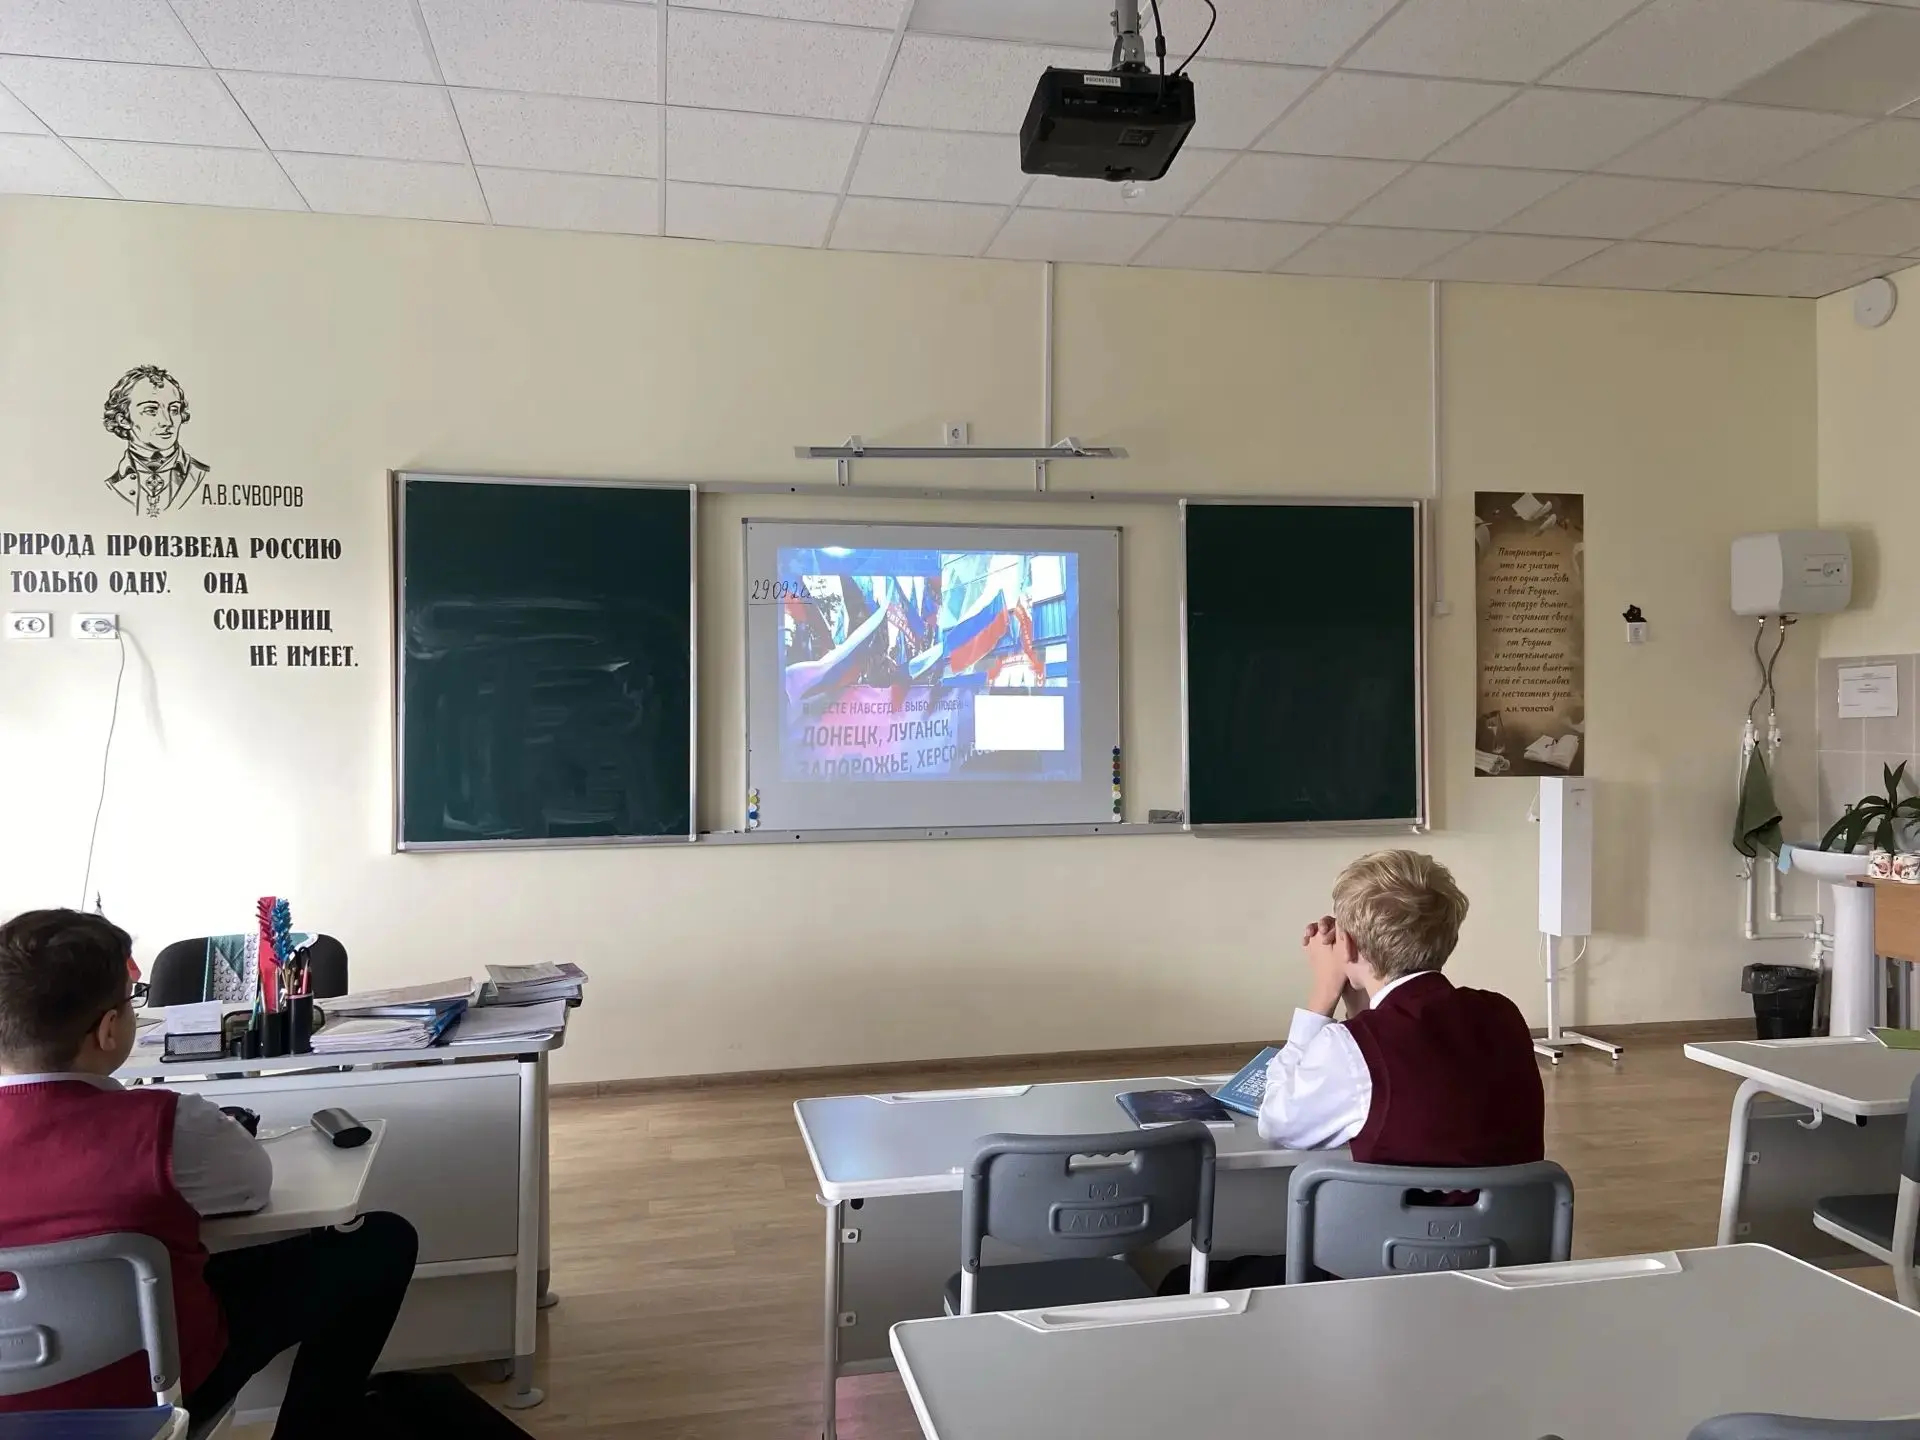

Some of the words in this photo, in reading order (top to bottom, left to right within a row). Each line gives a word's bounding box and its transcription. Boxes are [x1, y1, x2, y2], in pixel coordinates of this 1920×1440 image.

[202, 484, 304, 508] А.В.СУВОРОВ
[107, 534, 239, 559] ПРОИЗВЕЛА
[250, 537, 342, 560] РОССИЮ
[11, 570, 98, 594] ТОЛЬКО
[109, 571, 171, 595] ОДНУ.
[204, 572, 249, 594] ОНА
[214, 608, 333, 632] СОПЕРНИЦ
[250, 645, 277, 667] НЕ
[287, 645, 359, 668] ИМЕЕТ.
[802, 725, 883, 749] ДОНЕЦК,
[887, 719, 953, 742] ЛУГАНСК,
